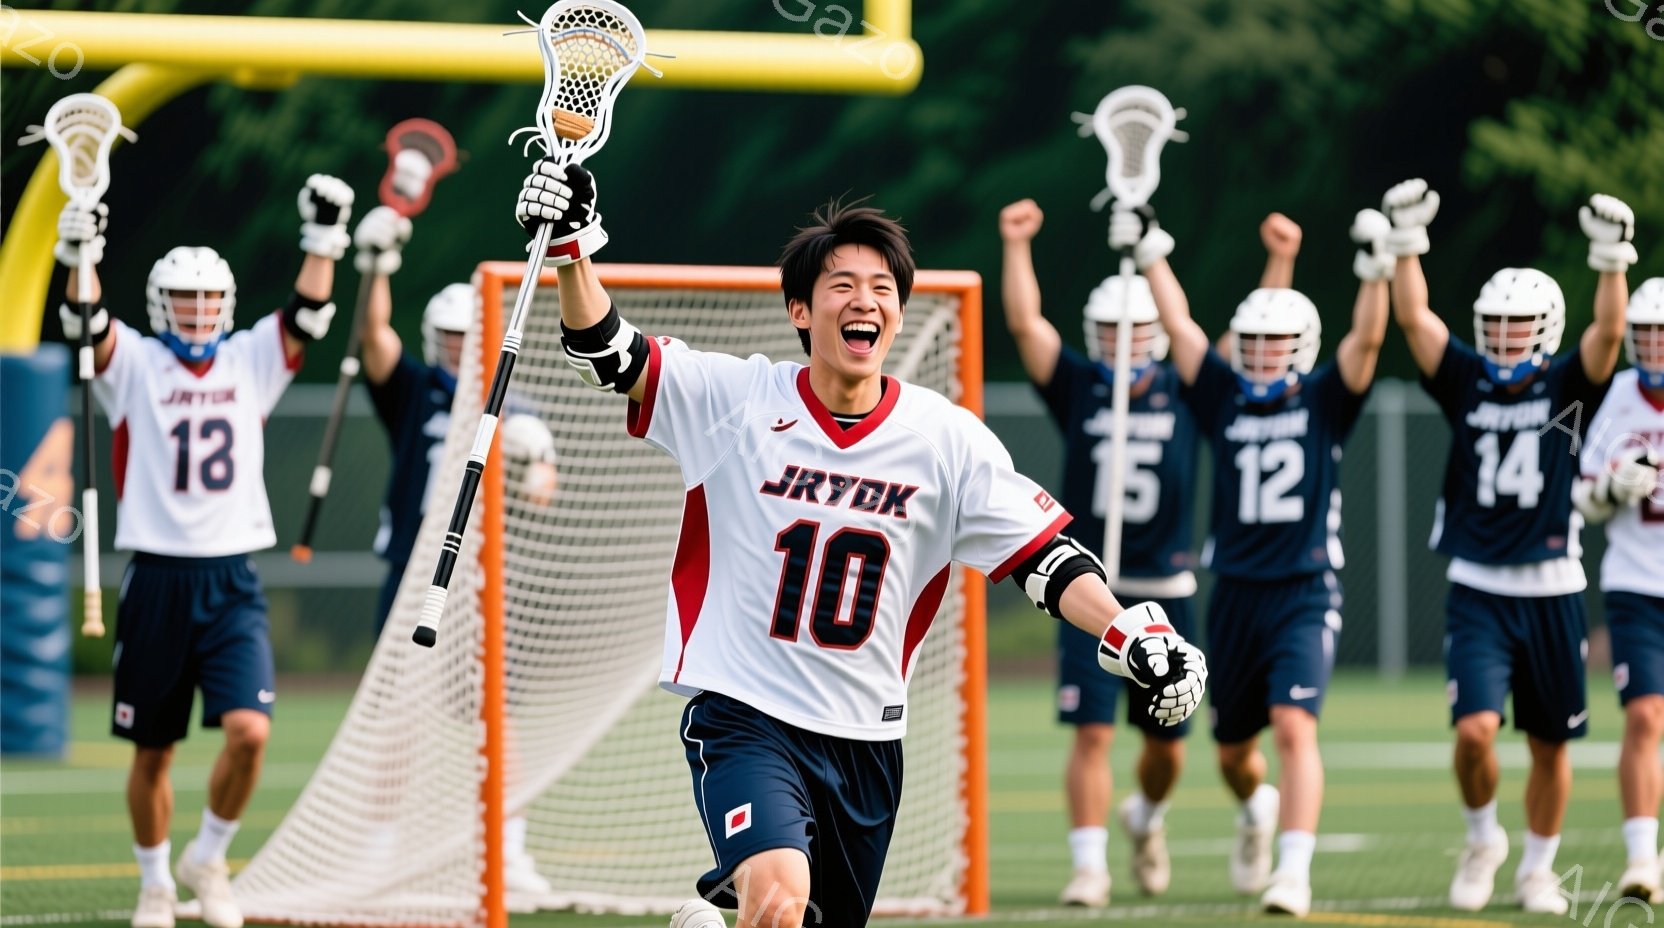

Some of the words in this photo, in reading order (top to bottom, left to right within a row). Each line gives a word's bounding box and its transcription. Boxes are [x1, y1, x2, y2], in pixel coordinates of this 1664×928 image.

[1235, 439, 1305, 523] 12
[1475, 430, 1544, 509] 14
[769, 518, 891, 651] 10
